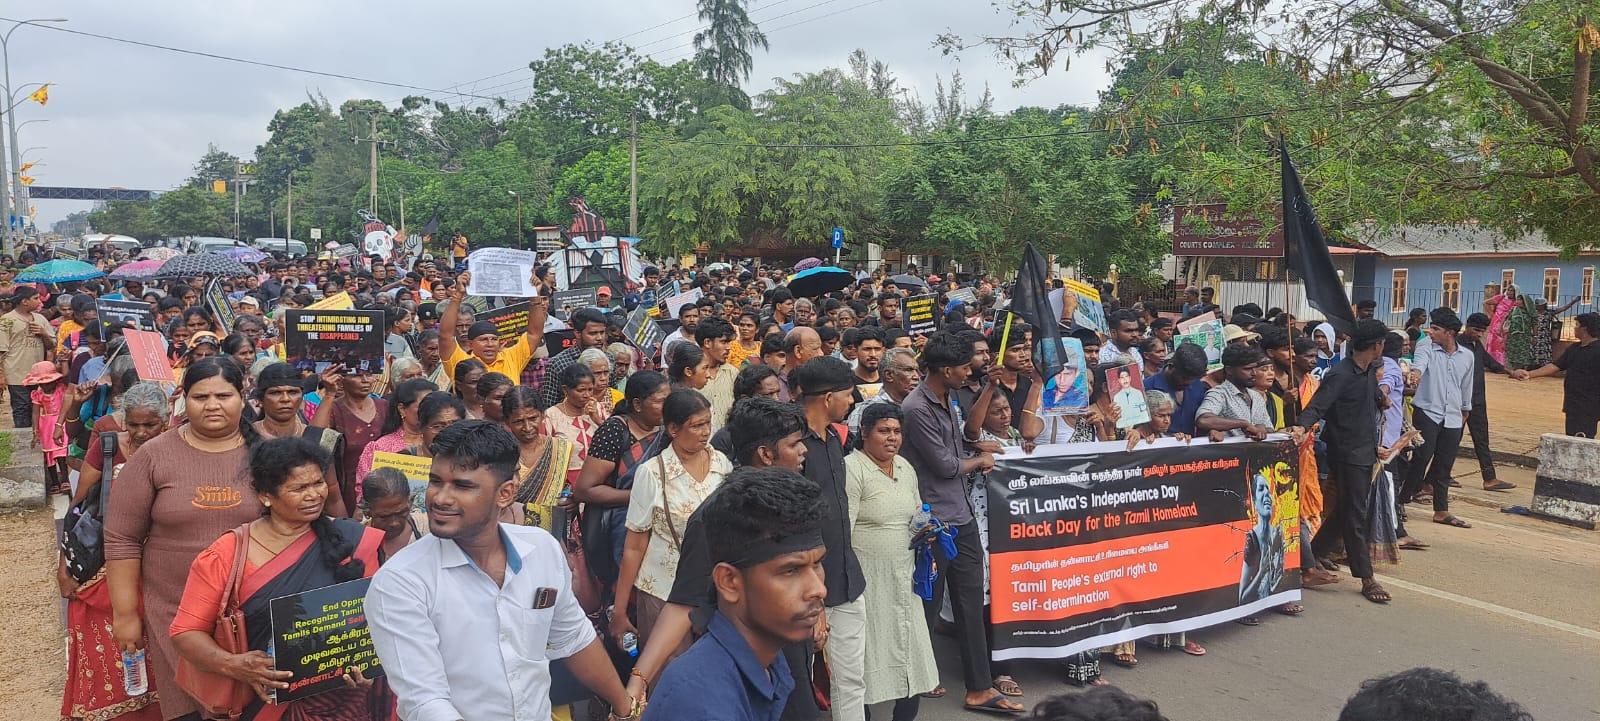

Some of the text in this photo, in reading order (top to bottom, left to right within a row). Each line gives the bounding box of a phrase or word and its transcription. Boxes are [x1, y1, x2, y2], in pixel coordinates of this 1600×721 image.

[834, 231, 840, 245] P
[1179, 241, 1202, 249] COURTS
[300, 315, 370, 324] STOP INTIMIDATING AND
[297, 324, 336, 332] THREATENING
[337, 324, 364, 332] FAMILIES
[307, 332, 319, 340] THE
[1029, 471, 1089, 486] லங்காவின்
[1091, 468, 1123, 483] சுதந்திர
[1124, 466, 1142, 480] நாள்
[1143, 464, 1168, 478] தமிழர்
[194, 486, 241, 502] Smile
[1009, 484, 1179, 515] Sri Lanka's Independence Day
[1010, 501, 1198, 539] Black Day for the Tamil Homeland
[1010, 559, 1059, 573] தமிழரின்
[1011, 579, 1047, 593] Tamil
[1051, 574, 1090, 592] People's
[1126, 562, 1147, 578] right
[1148, 561, 1158, 573] to
[322, 603, 339, 613] End
[1012, 590, 1109, 612] self-determination
[295, 613, 339, 629] Recognize
[282, 629, 311, 641] Tamils
[312, 620, 347, 634] Demand
[300, 642, 357, 665] முடிவடைய
[318, 653, 351, 674] தமிழர்
